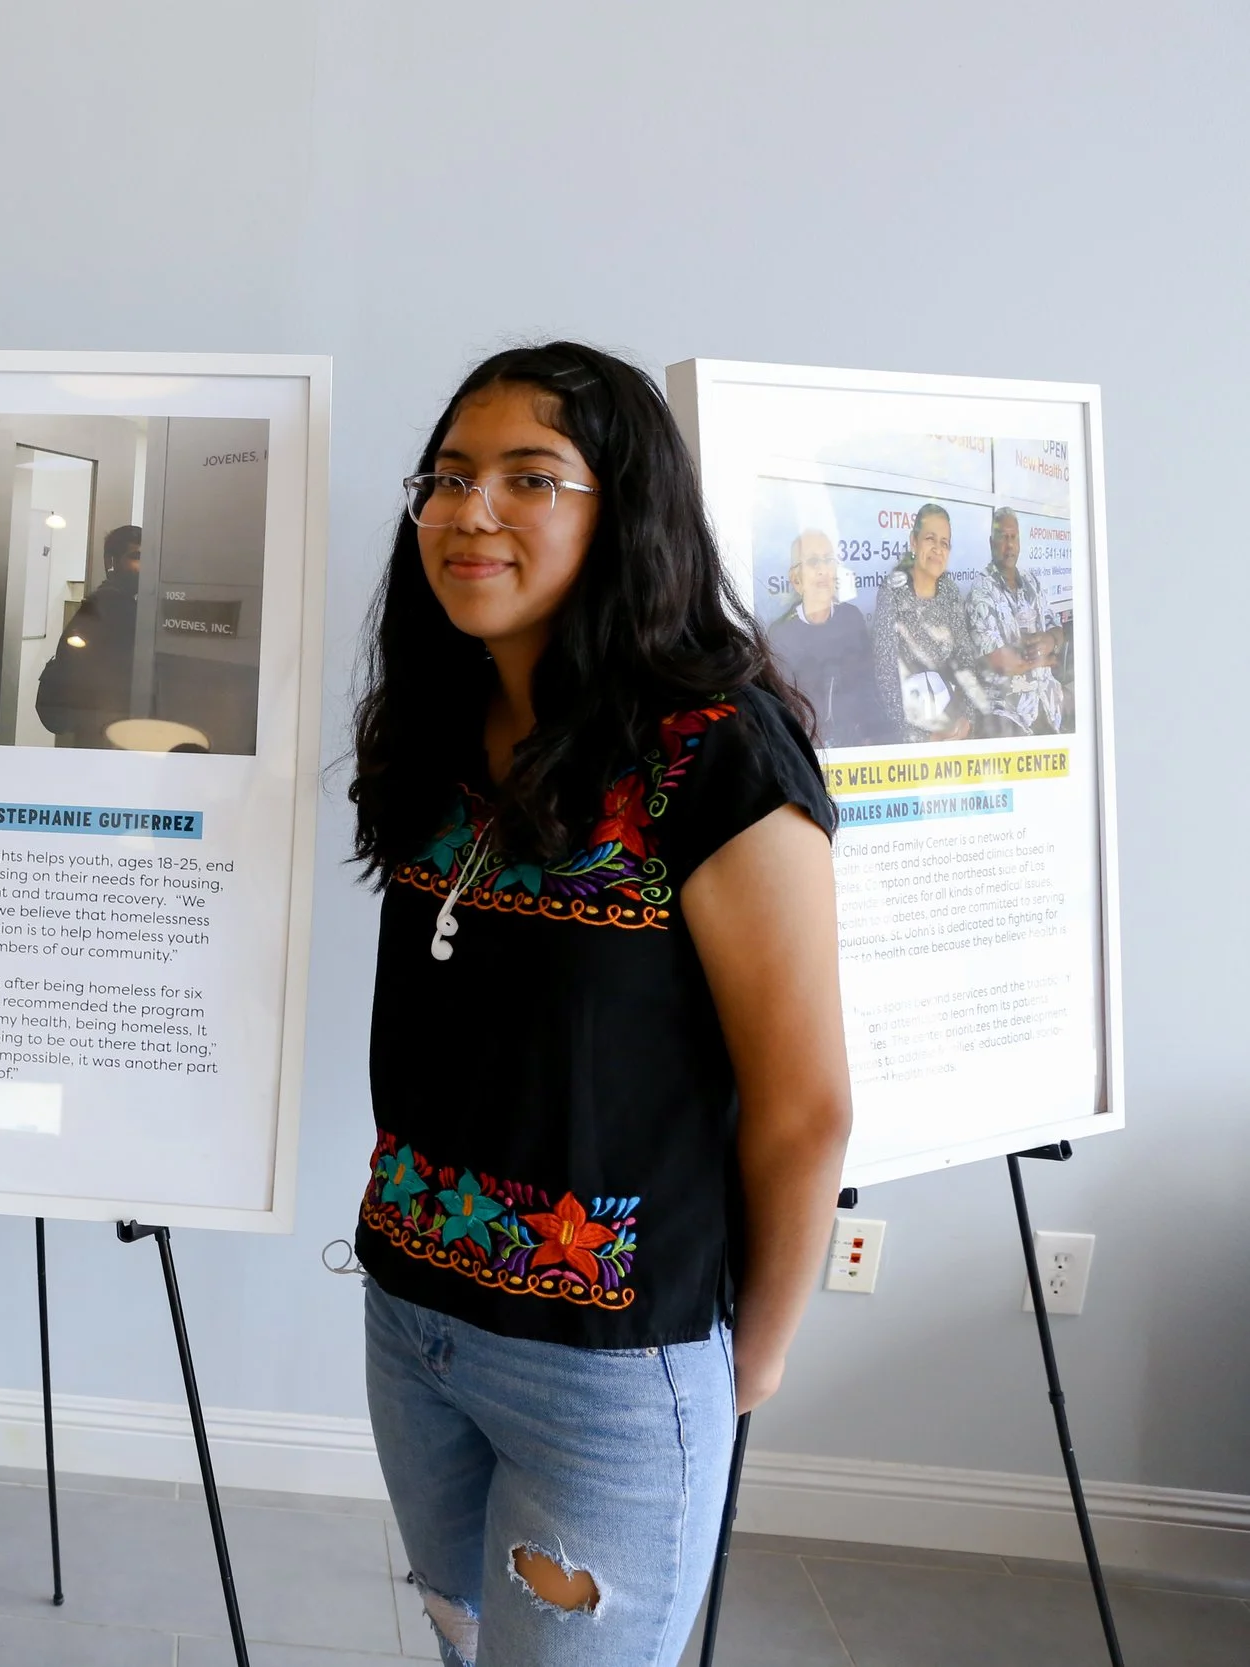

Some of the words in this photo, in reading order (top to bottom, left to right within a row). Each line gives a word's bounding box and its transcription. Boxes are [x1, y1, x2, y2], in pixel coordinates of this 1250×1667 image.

[202, 451, 259, 467] JOVENES,
[1016, 449, 1035, 471] New
[1039, 456, 1063, 480] Health
[165, 592, 186, 601] 1052
[162, 618, 208, 633] JOVENES,
[211, 623, 233, 635] INC.
[848, 766, 883, 785] WELL
[888, 763, 929, 782] CHILD
[935, 760, 962, 779] AND
[967, 757, 1011, 776] FAMILY
[1017, 753, 1066, 773] CENTER
[840, 804, 882, 822] ORALES
[886, 802, 909, 818] AND
[913, 798, 957, 816] JASMYN
[961, 794, 1008, 811] MORALES
[99, 812, 194, 832] GUTIERREZ
[842, 843, 868, 858] Child
[870, 841, 890, 855] and
[892, 838, 923, 852] Family
[925, 836, 958, 849] Center
[959, 833, 966, 845] is
[968, 835, 975, 844] a
[977, 829, 1014, 844] network
[1016, 826, 1026, 840] of
[27, 850, 64, 867] helps
[68, 853, 112, 868] youth,
[117, 857, 153, 871] ages
[157, 856, 201, 872] 18-25,
[205, 859, 233, 872] end
[32, 871, 50, 882] on
[55, 870, 88, 883] their
[92, 873, 135, 886] needs
[140, 873, 159, 887] for
[163, 875, 223, 894] housing,
[11, 887, 39, 899] and
[44, 888, 98, 902] trauma
[103, 893, 166, 909] recovery.
[175, 895, 205, 908] “We
[20, 904, 71, 919] believe
[75, 907, 106, 921] that
[110, 909, 209, 927] homelessness
[904, 923, 936, 939] John's
[937, 922, 945, 935] is
[946, 915, 994, 933] dedicated
[995, 916, 1007, 926] to
[1008, 911, 1043, 927] fighting
[1045, 907, 1058, 920] for
[26, 923, 37, 936] is
[40, 924, 57, 937] to
[60, 925, 92, 941] help
[95, 926, 164, 942] homeless
[167, 932, 209, 946] youth
[42, 942, 59, 955] of
[60, 946, 85, 956] our
[87, 947, 178, 964] community.”
